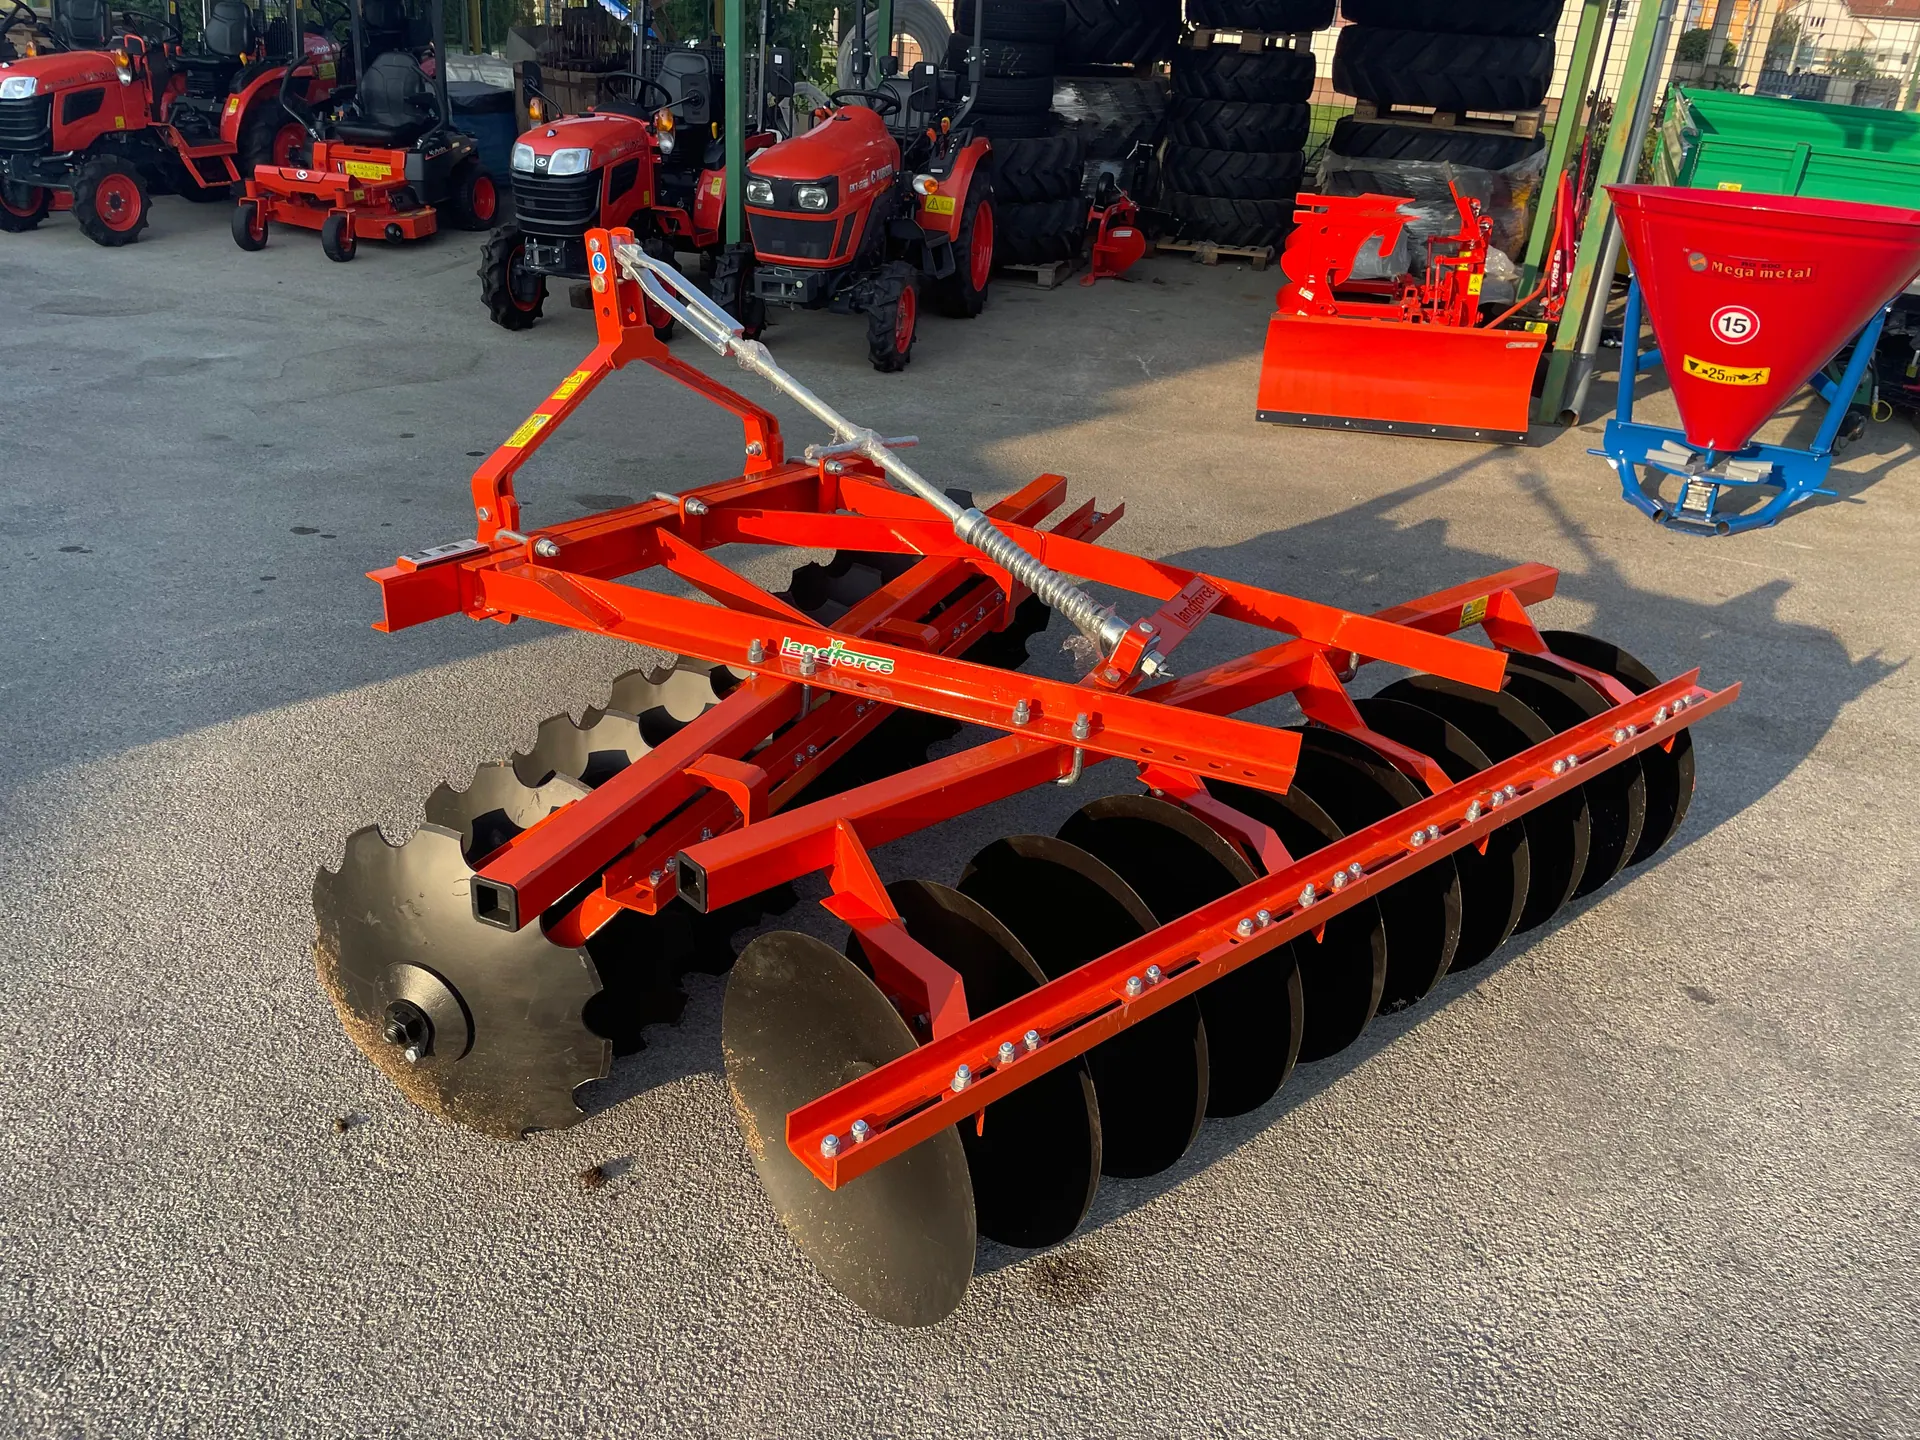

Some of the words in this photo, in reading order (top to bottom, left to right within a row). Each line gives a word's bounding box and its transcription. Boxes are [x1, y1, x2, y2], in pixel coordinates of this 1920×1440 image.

[1711, 261, 1755, 278] Mega
[1760, 267, 1812, 279] metal
[1722, 316, 1747, 334] 15
[1174, 585, 1216, 624] landforce
[780, 637, 895, 675] landforce
